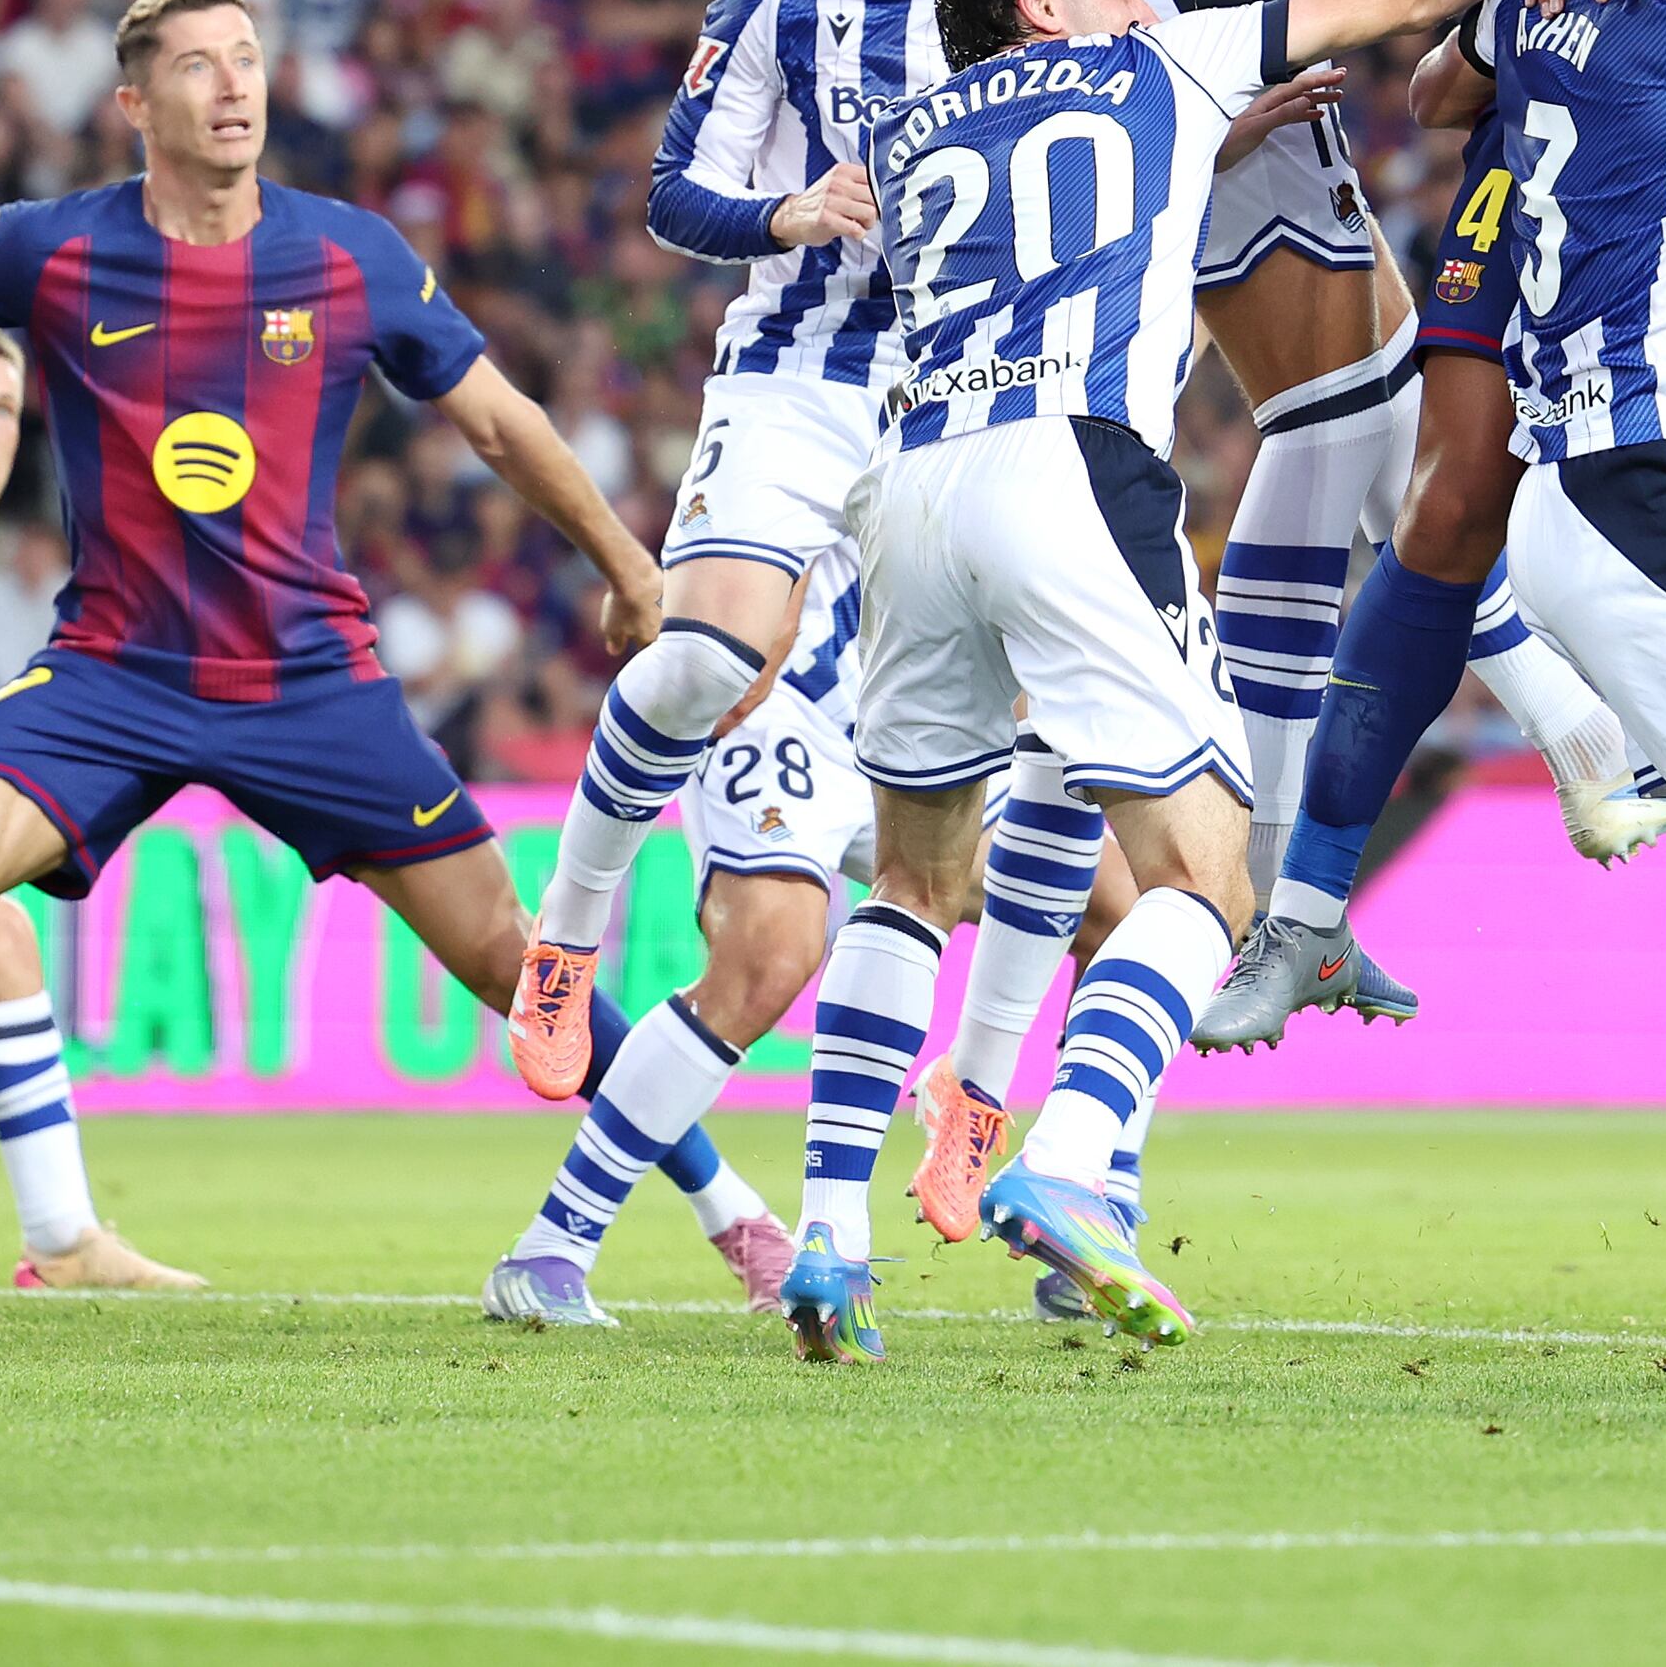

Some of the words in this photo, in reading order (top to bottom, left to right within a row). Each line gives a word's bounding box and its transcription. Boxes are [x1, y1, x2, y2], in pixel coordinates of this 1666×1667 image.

[887, 59, 1136, 173] ODRIOZOLA
[903, 111, 1136, 329] 20
[1456, 168, 1513, 253] 4
[1520, 99, 1578, 308] 3
[691, 419, 730, 486] 5
[722, 736, 814, 806] 28
